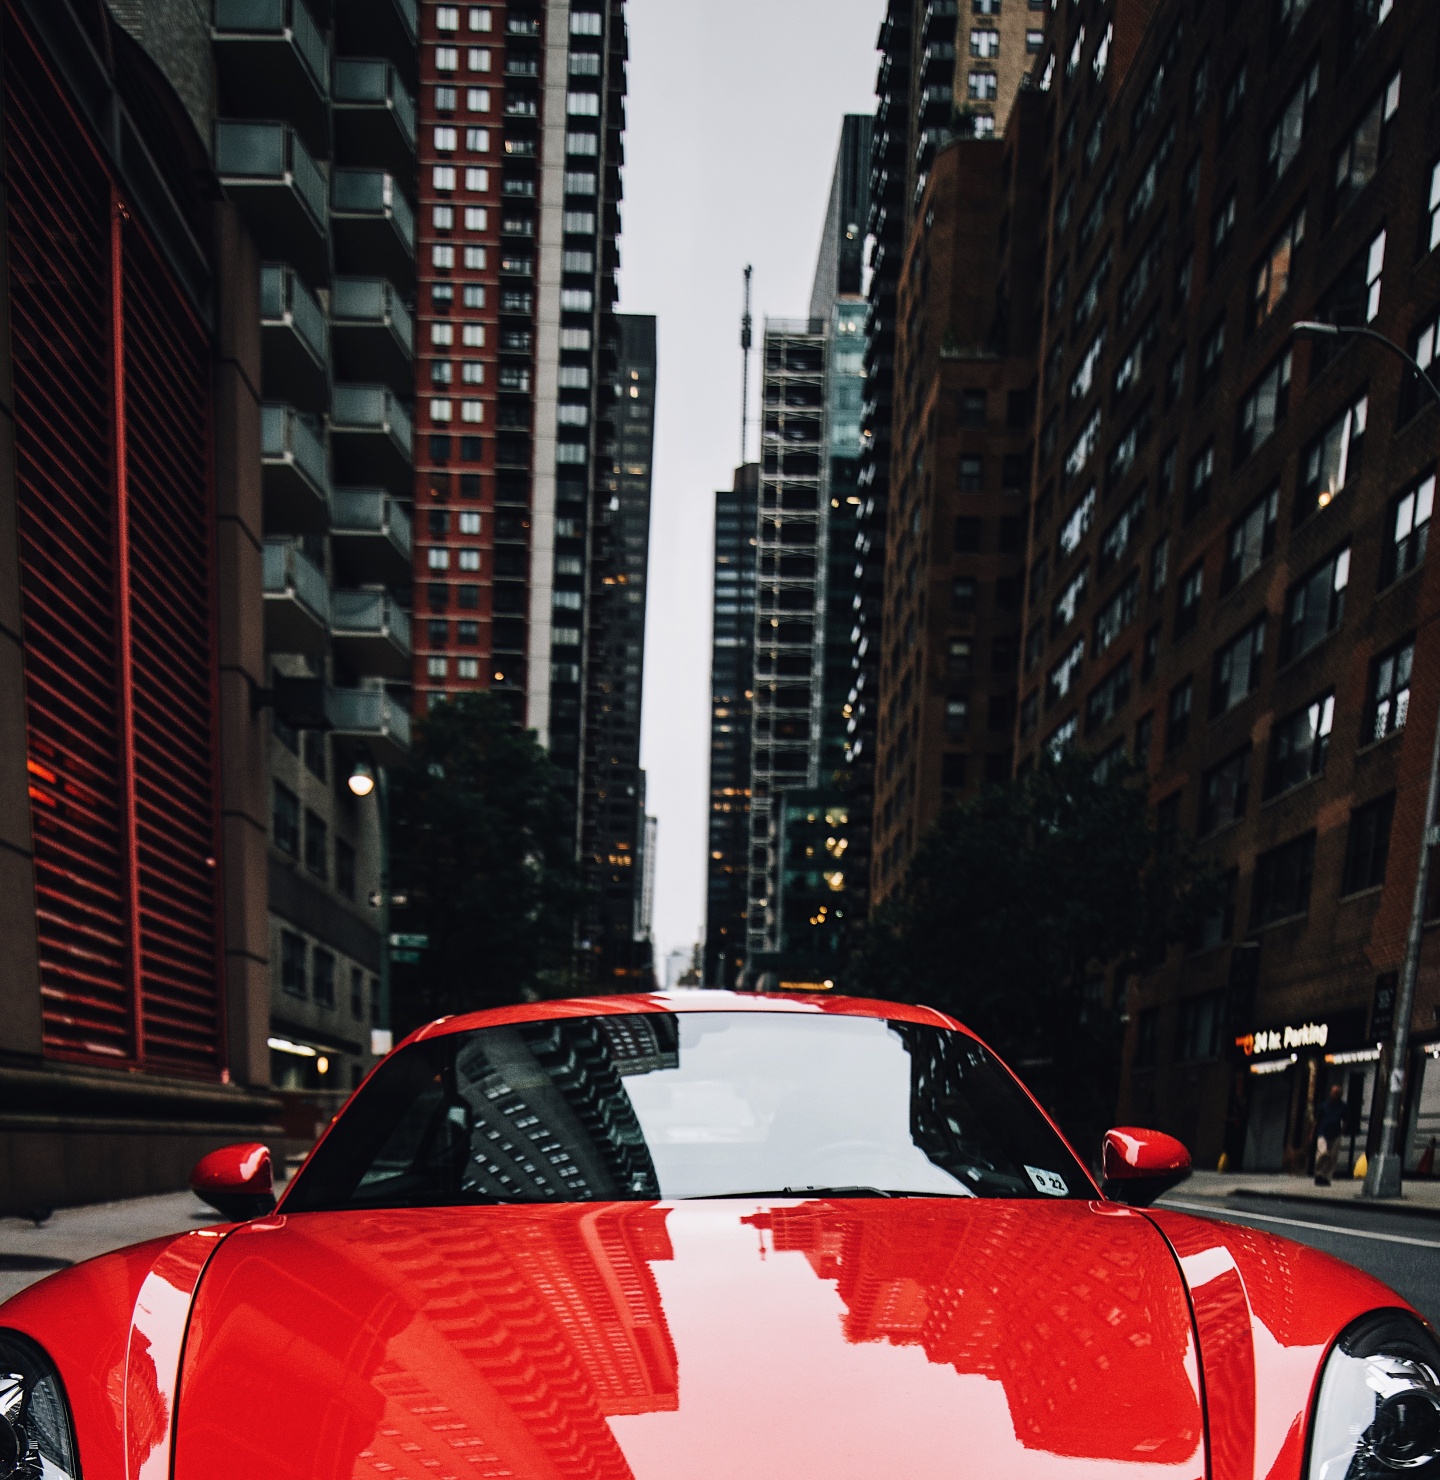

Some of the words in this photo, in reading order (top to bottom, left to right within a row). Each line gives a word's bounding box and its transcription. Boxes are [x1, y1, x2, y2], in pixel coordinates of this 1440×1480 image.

[1254, 1031, 1268, 1054] 24
[1284, 1022, 1328, 1049] Parking
[1048, 1177, 1065, 1191] 22
